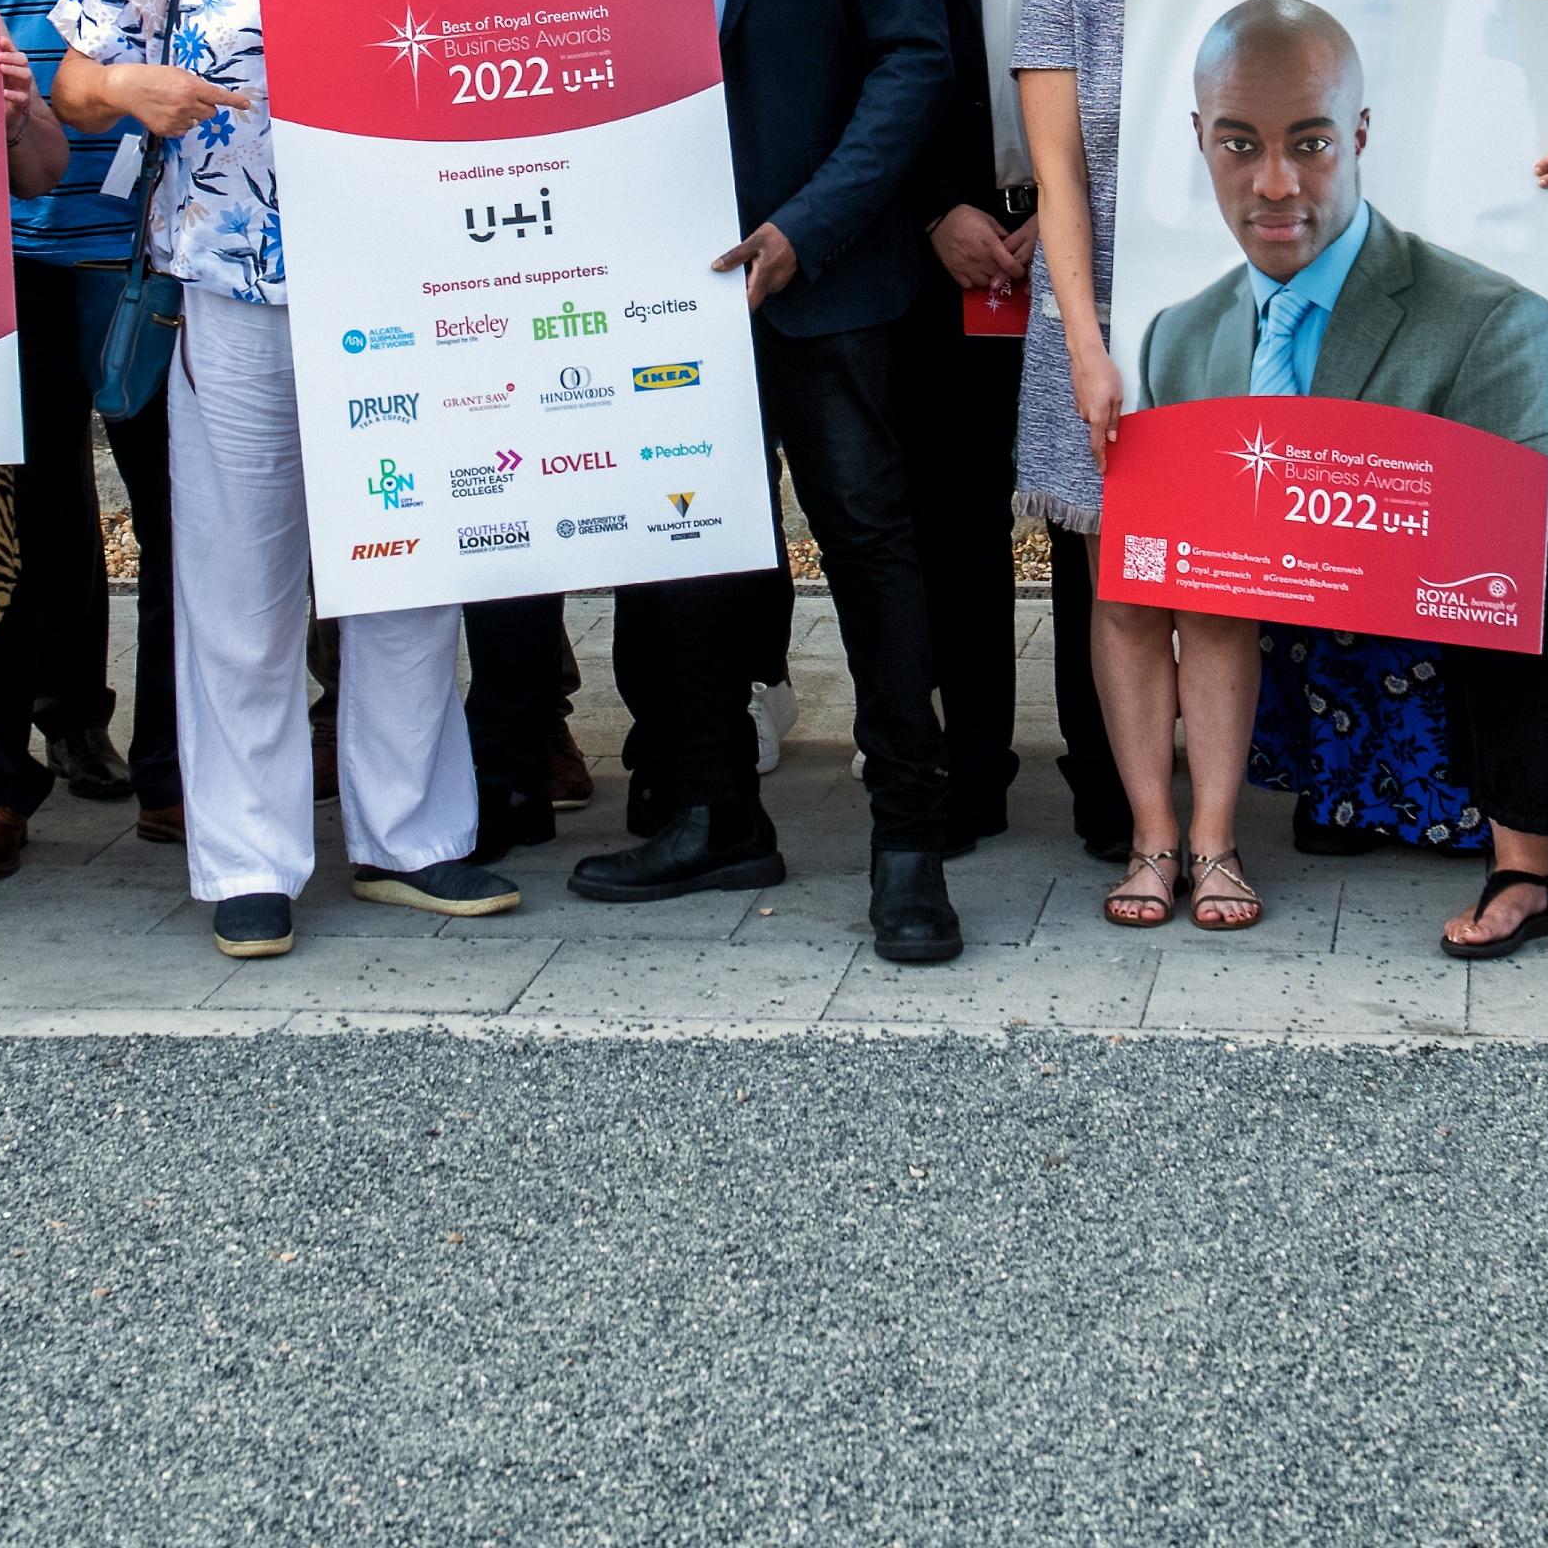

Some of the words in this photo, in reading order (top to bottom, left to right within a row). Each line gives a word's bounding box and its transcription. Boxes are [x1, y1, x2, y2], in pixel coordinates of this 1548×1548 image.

[442, 20, 472, 35] Best
[475, 17, 491, 32] of
[494, 12, 531, 31] Royal
[534, 5, 609, 25] Greenwich
[444, 35, 530, 59] Business
[535, 24, 611, 49] Awards
[449, 56, 554, 105] 2022
[438, 165, 504, 183] Headline
[508, 159, 570, 178] sponsor:
[422, 277, 491, 297] Sponsors
[493, 272, 522, 288] and
[525, 265, 609, 285] supporters:
[369, 326, 404, 336] ALCATEL
[435, 314, 509, 339] Berkeley
[369, 332, 415, 343] SUBMARINE
[370, 340, 416, 351] NETWORKS
[436, 338, 460, 346] Designed
[641, 369, 693, 384] IKEA
[442, 395, 483, 409] GRANT
[485, 392, 510, 404] SAW
[540, 386, 616, 405] HINDWOODS
[348, 392, 420, 430] DRURY
[544, 403, 578, 413] CHARTERED
[359, 419, 374, 430] TEA
[382, 414, 412, 425] COFFEE
[655, 440, 713, 459] Peabody
[1285, 444, 1312, 460] Best
[1314, 449, 1328, 461] of
[1331, 450, 1364, 467] Royal
[1366, 453, 1434, 473] Greenwich
[450, 465, 495, 479] LONDON
[541, 451, 617, 476] LOVELL
[450, 475, 488, 489] SOUTH
[489, 473, 515, 484] EAST
[1284, 462, 1360, 487] Business
[1363, 471, 1432, 495] Awards
[451, 484, 504, 499] COLLEGES
[400, 500, 424, 509] AIRPORT
[1284, 485, 1378, 531] 2022
[457, 523, 498, 539] SOUTH
[500, 520, 529, 534] EAST
[577, 515, 618, 527] UNIVERSITY
[618, 514, 627, 523] OF
[578, 521, 629, 535] GREENWICH
[646, 520, 692, 534] WILLMOTT
[693, 517, 723, 528] DIXON
[351, 538, 421, 561] RINEY
[458, 531, 530, 550] LONDON
[459, 548, 489, 556] CHAMBER
[497, 542, 531, 552] COMMERCE
[1191, 546, 1272, 565] GreenwichBizAwards
[1296, 559, 1364, 576] Royal_Greenwich
[1190, 565, 1252, 581] royal_greenwich
[1262, 572, 1349, 592] #GreenwichBizAwards
[1175, 578, 1315, 603] royalgreenwich.gov.uk/businessawards
[1416, 587, 1469, 607] ROYAL
[1470, 597, 1506, 611] borough
[1506, 602, 1518, 613] of
[1415, 602, 1518, 628] GREENWICH
